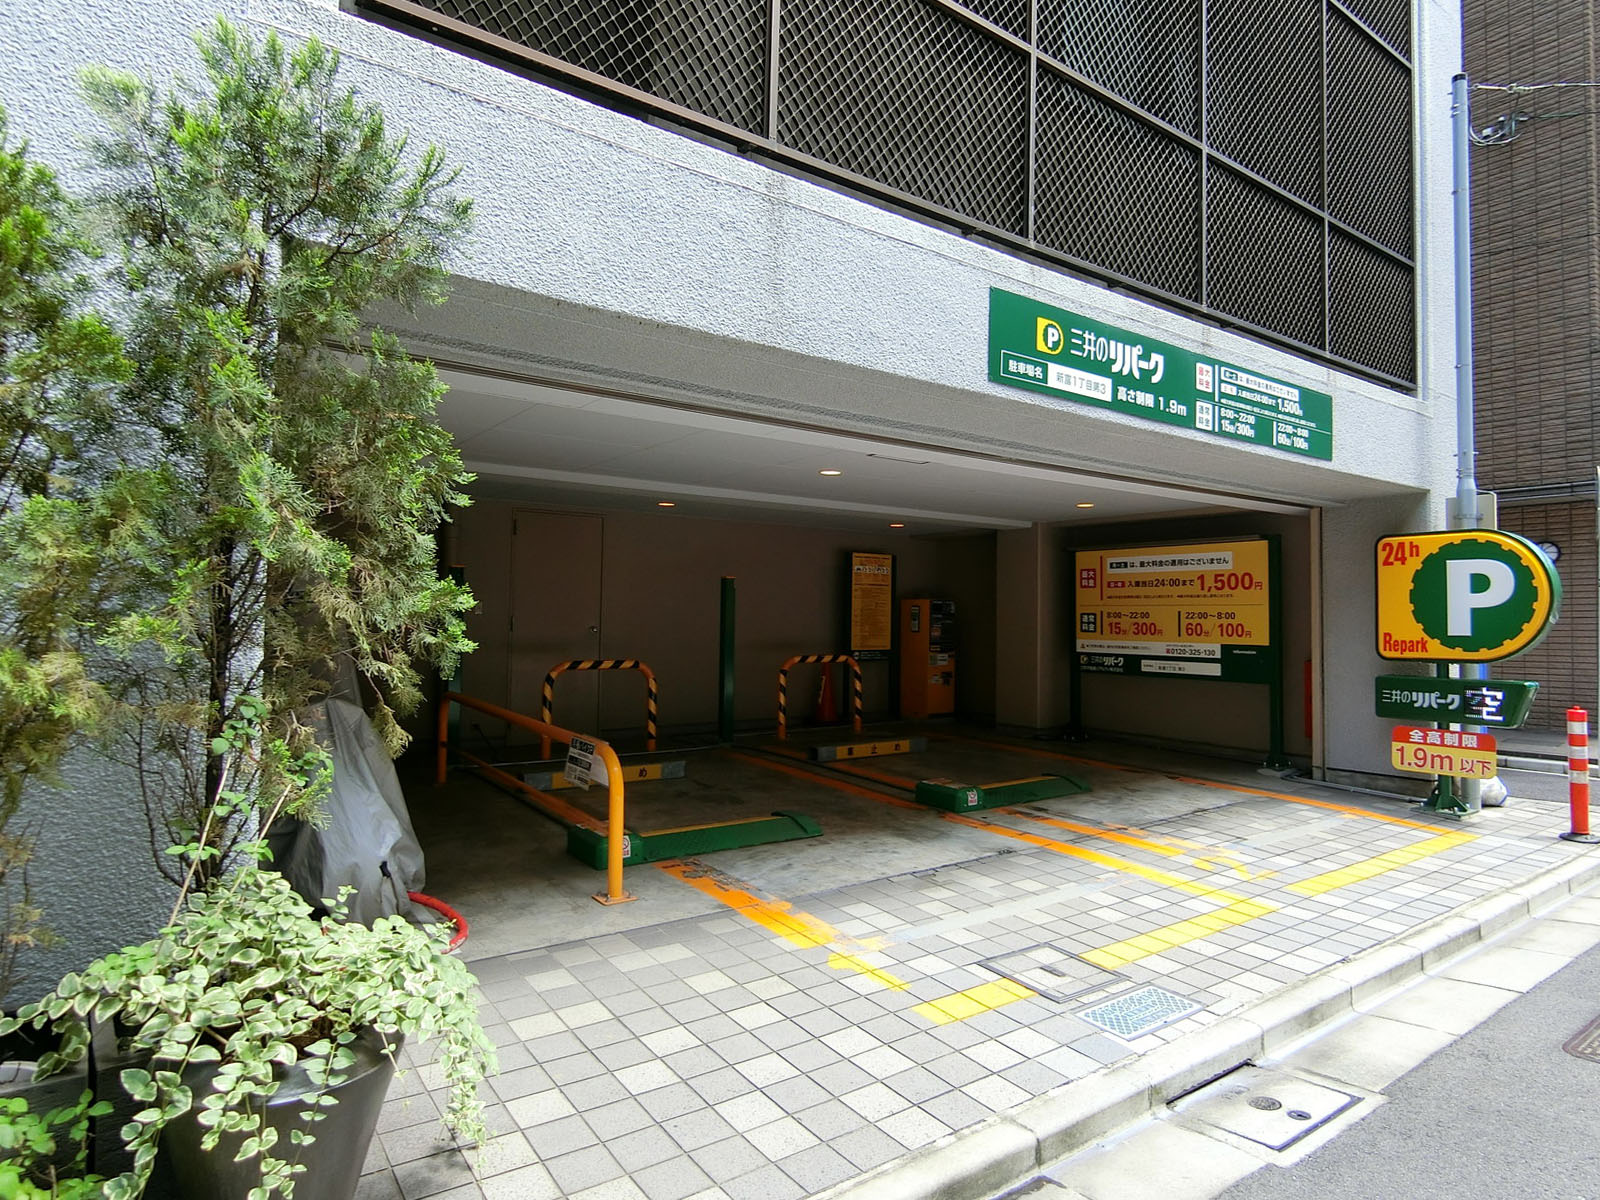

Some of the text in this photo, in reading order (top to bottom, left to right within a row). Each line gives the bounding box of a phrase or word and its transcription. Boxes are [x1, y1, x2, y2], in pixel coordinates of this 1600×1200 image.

[1047, 327, 1060, 348] P
[1070, 328, 1165, 384] 三井のリパーク
[1117, 385, 1187, 417] 高さ制限 1.9m
[1196, 572, 1263, 593] 1,500円
[1446, 558, 1516, 637] P
[1382, 631, 1429, 655] Repark
[1382, 689, 1460, 710] 三井のリパーク
[1409, 729, 1478, 748] 全高制限
[1395, 746, 1492, 776] 1.9m 以下
